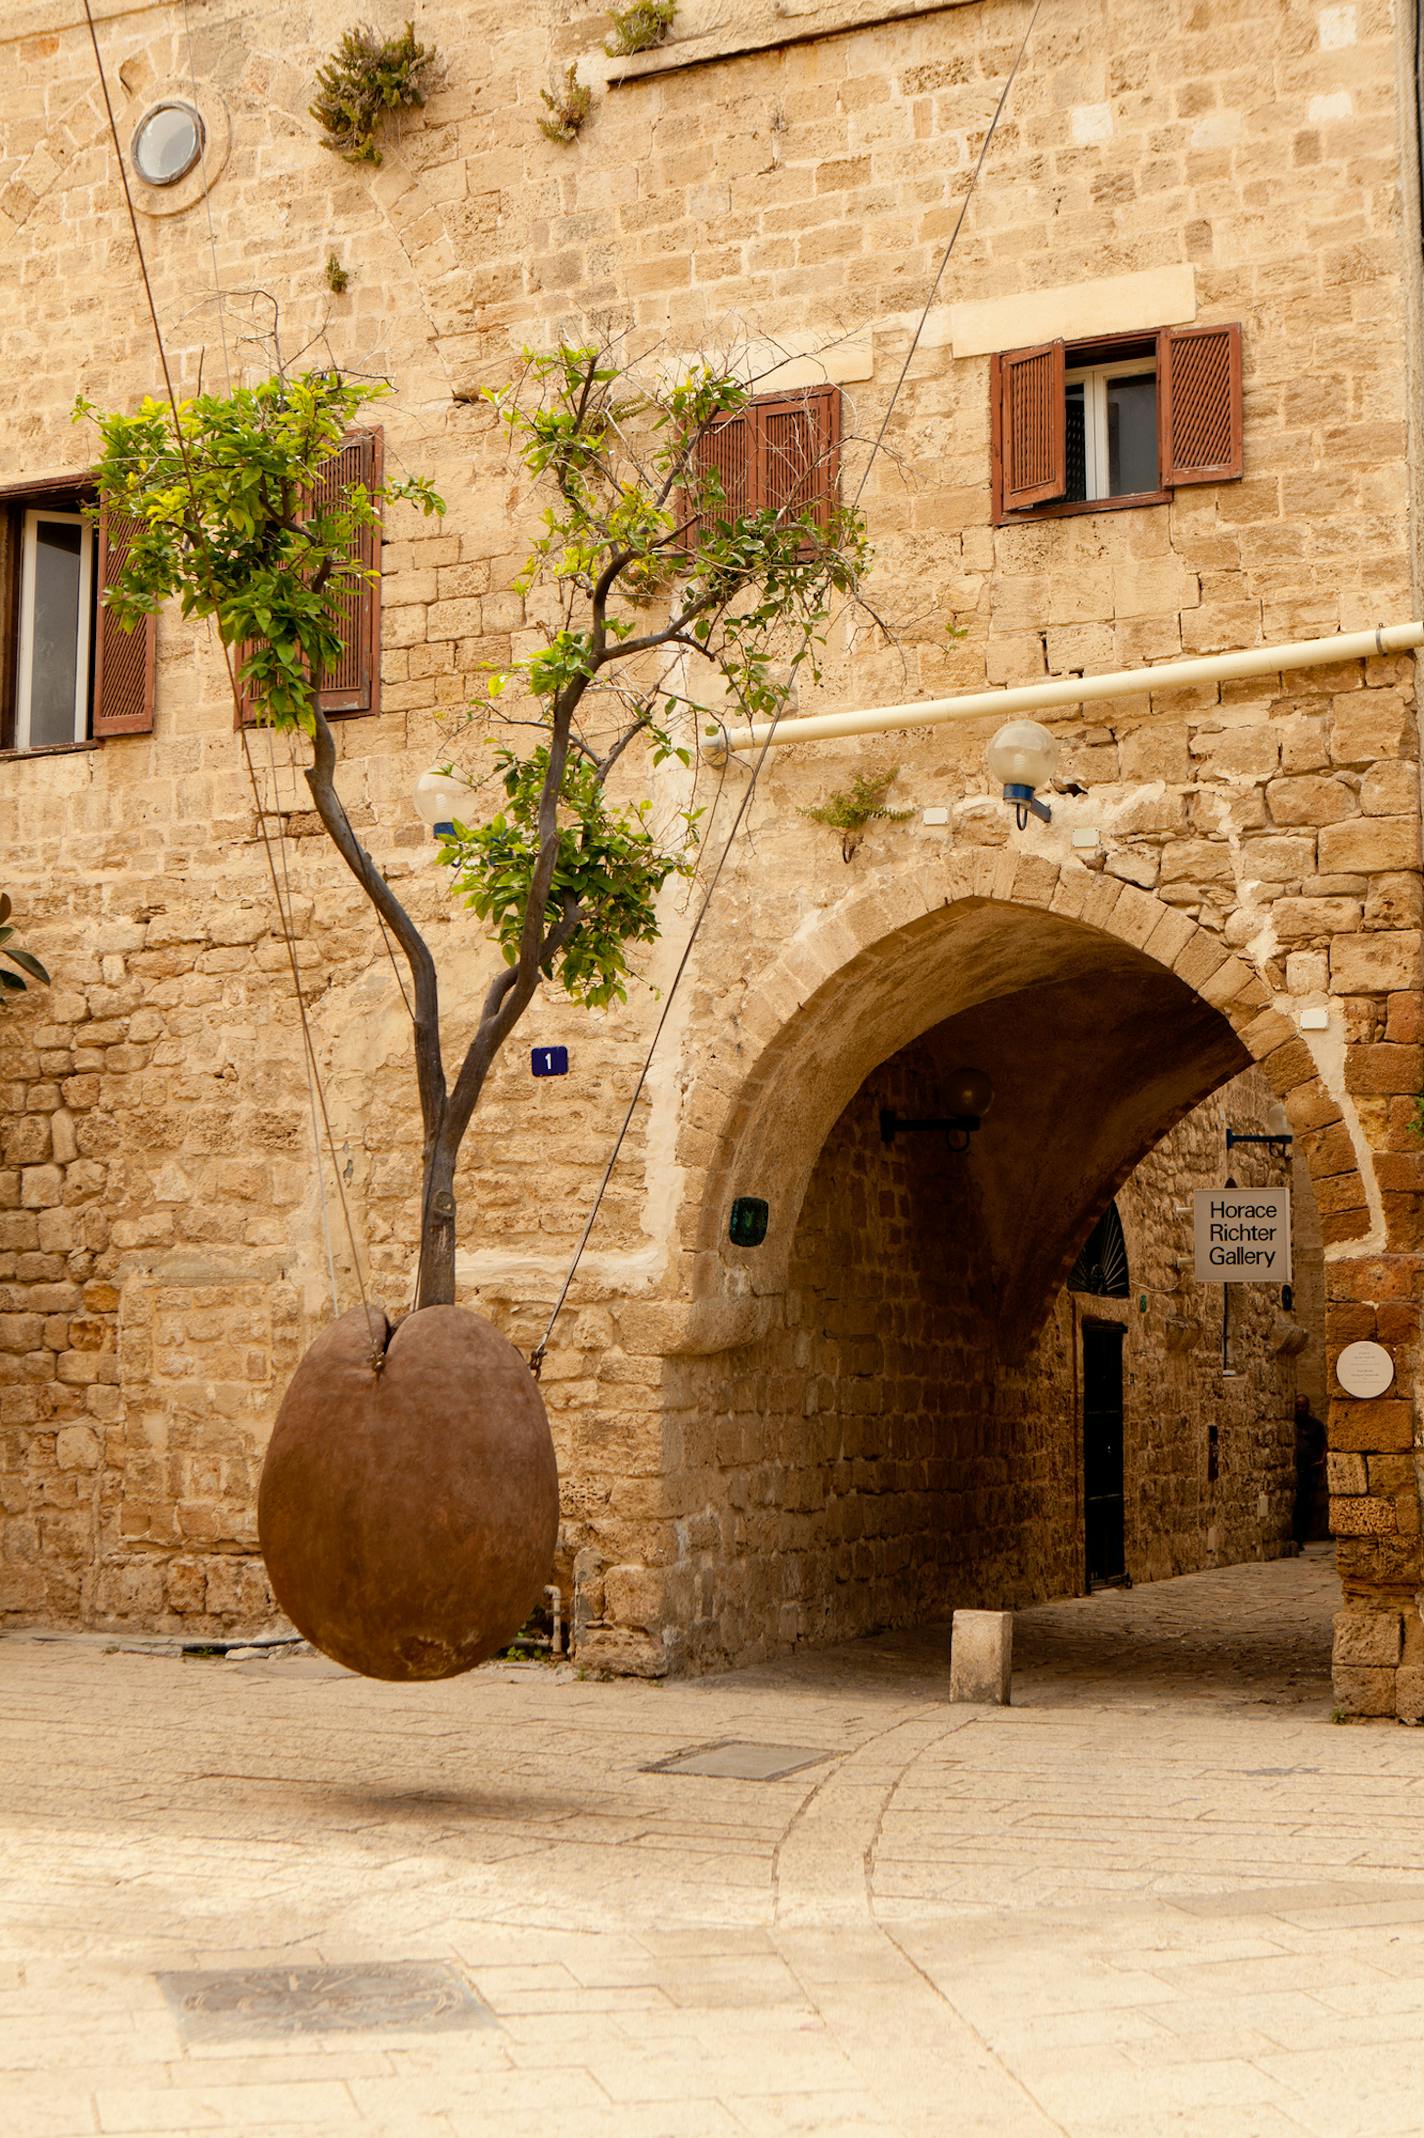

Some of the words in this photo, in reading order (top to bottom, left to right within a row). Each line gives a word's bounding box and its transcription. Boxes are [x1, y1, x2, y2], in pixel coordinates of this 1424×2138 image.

[545, 1053, 552, 1070] 1
[1210, 1201, 1277, 1218] Horace
[1210, 1223, 1277, 1241] Richter
[1209, 1246, 1276, 1268] Gallery
